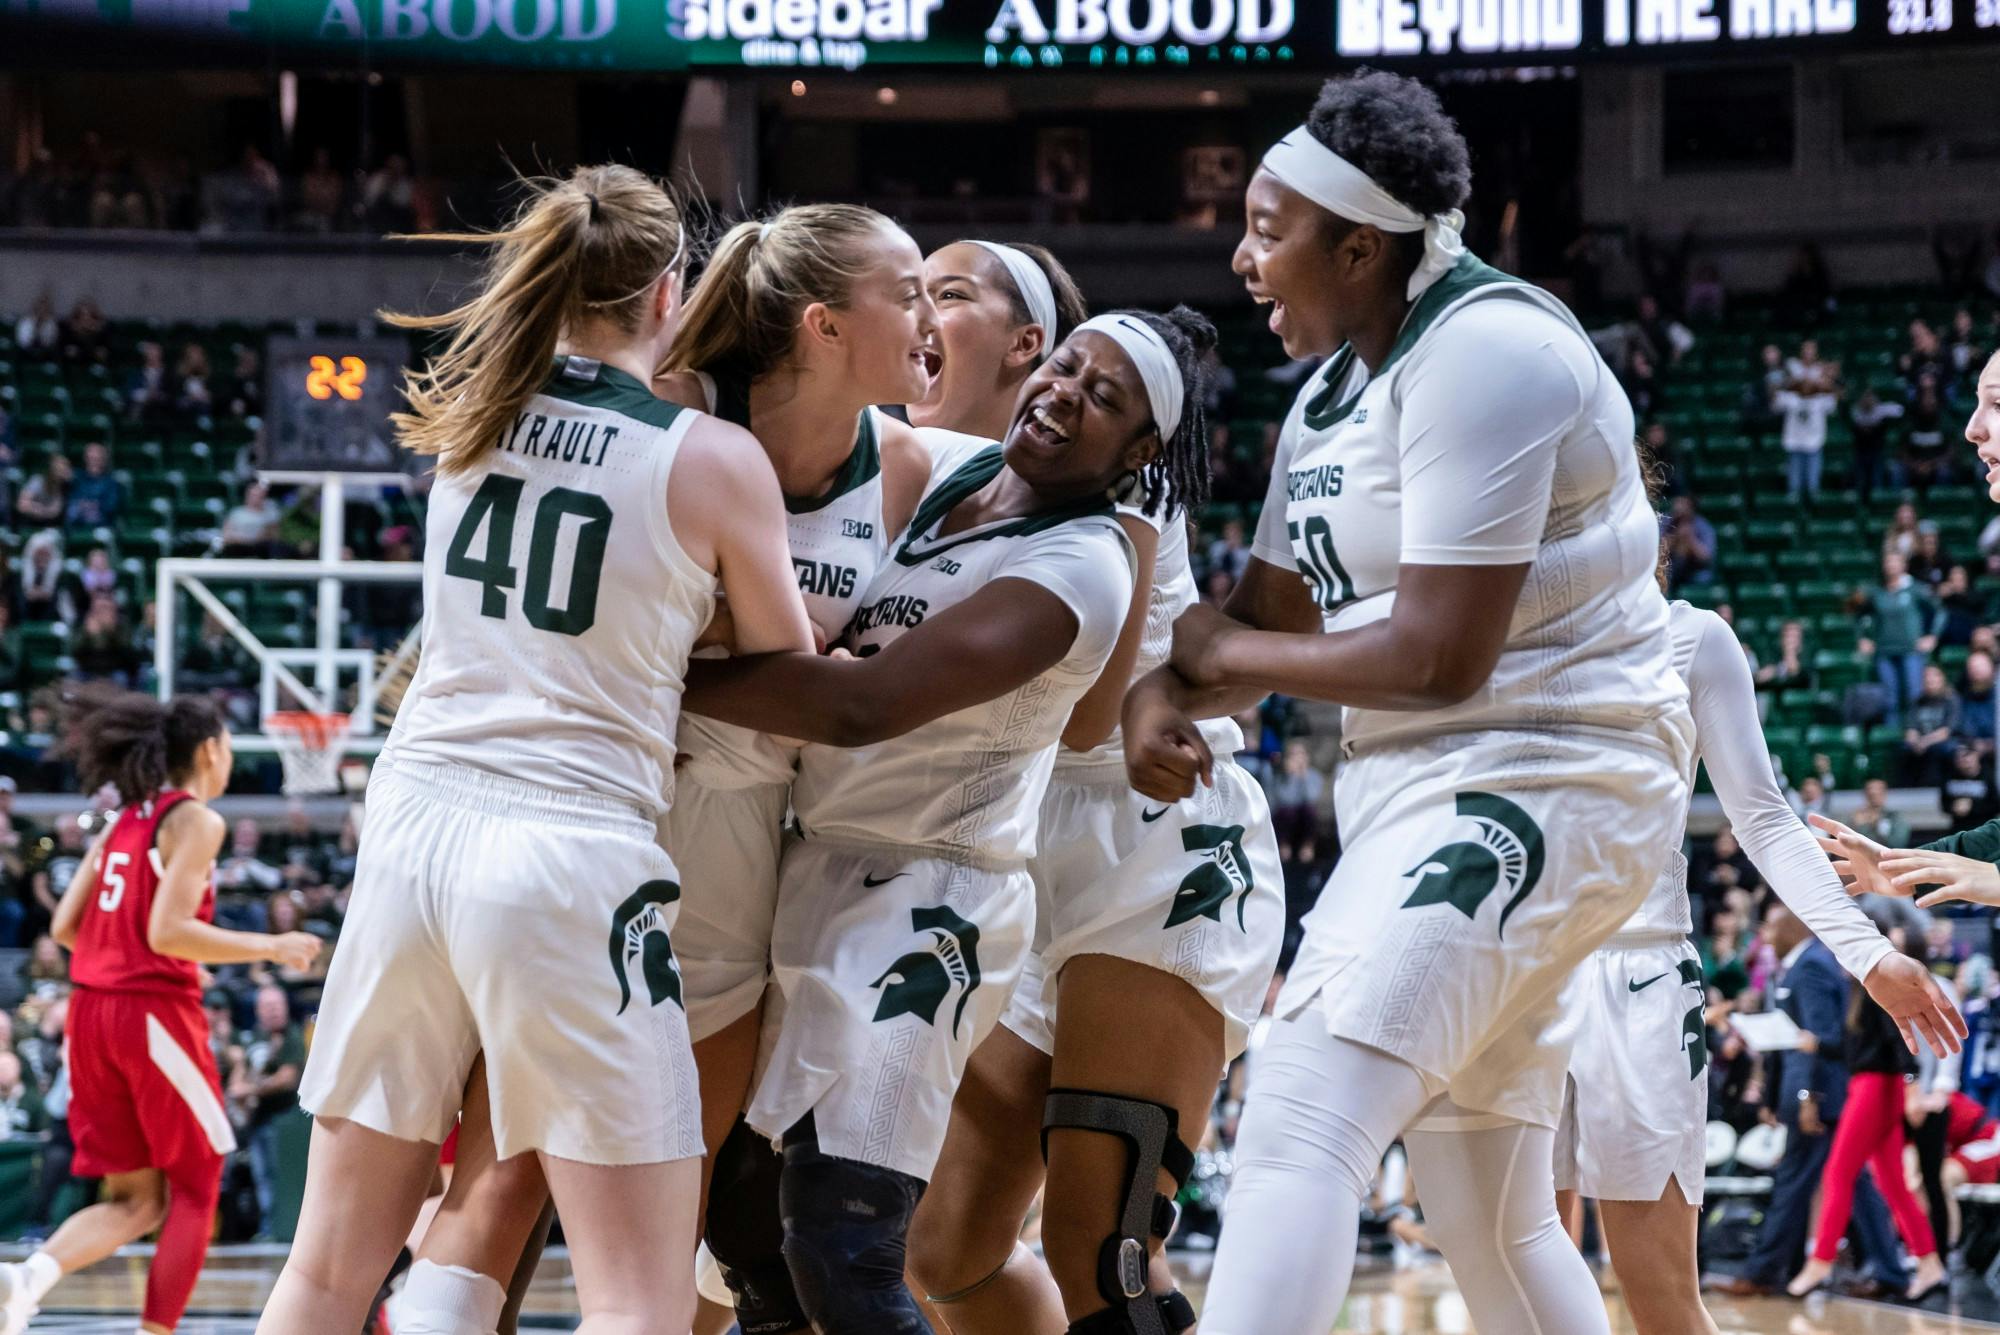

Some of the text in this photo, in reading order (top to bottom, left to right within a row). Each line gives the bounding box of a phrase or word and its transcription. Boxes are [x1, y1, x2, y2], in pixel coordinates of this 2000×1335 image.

[318, 0, 618, 43] ABOOD
[666, 0, 943, 41] sidebar
[984, 0, 1296, 45] ABOOD
[306, 355, 367, 400] 22
[495, 412, 620, 467] YRAULT
[445, 472, 614, 637] 40
